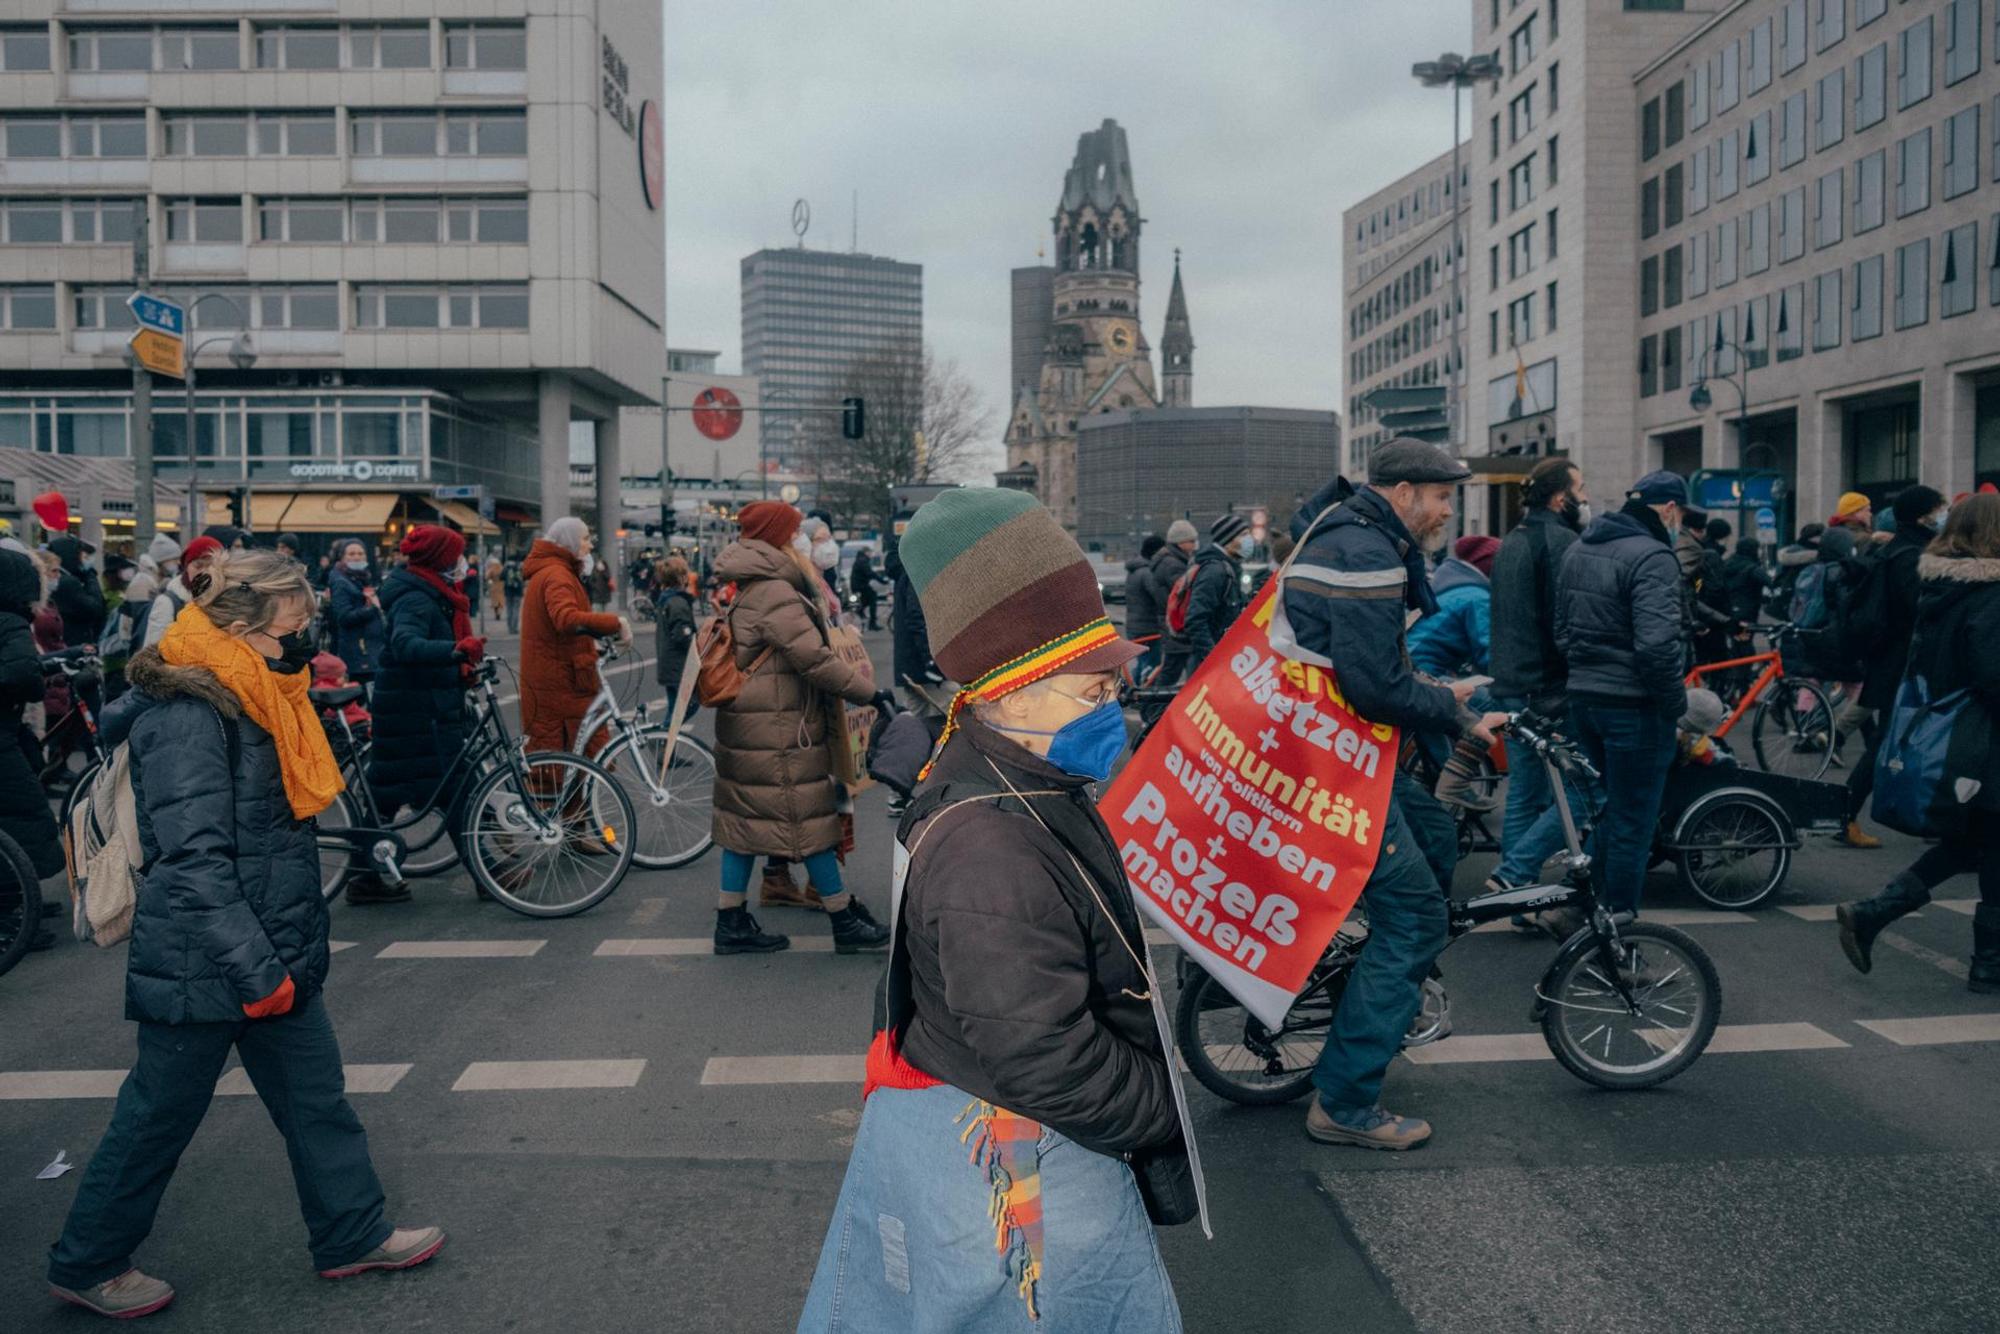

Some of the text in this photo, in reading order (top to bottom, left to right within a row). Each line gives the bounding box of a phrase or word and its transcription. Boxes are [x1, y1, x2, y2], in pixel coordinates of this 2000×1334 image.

[375, 464, 418, 477] COFFEE
[1184, 684, 1372, 845] Immunität
[1230, 645, 1380, 778] absetzen
[1257, 727, 1280, 753] +
[1164, 744, 1337, 893] aufheben
[1200, 747, 1303, 833] von Politikern
[1206, 834, 1227, 860] +
[1120, 838, 1267, 972] machen
[1122, 780, 1299, 946] Prozeß
